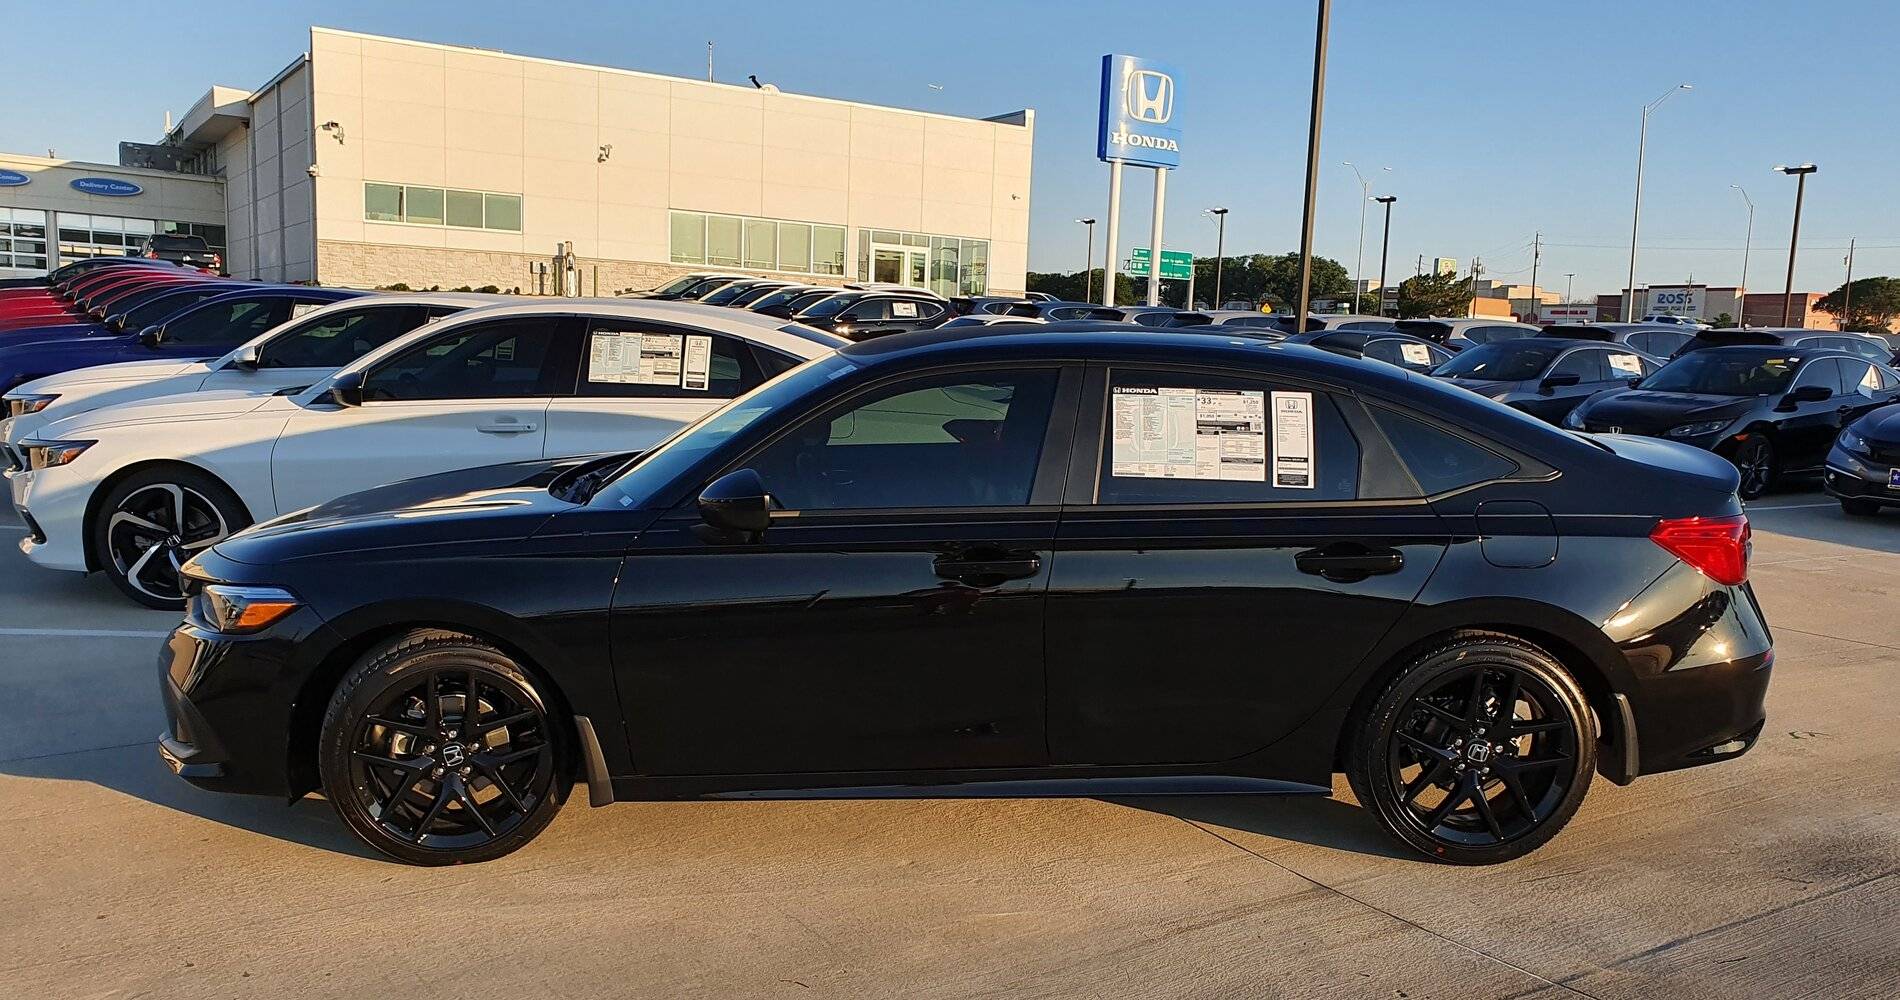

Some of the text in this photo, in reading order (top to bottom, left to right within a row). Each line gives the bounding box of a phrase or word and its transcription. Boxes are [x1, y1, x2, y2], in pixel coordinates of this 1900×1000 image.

[1111, 131, 1180, 152] HONDA
[80, 181, 135, 191] Delivery Center
[1657, 293, 1693, 304] ROSS
[1201, 397, 1212, 405] 33
